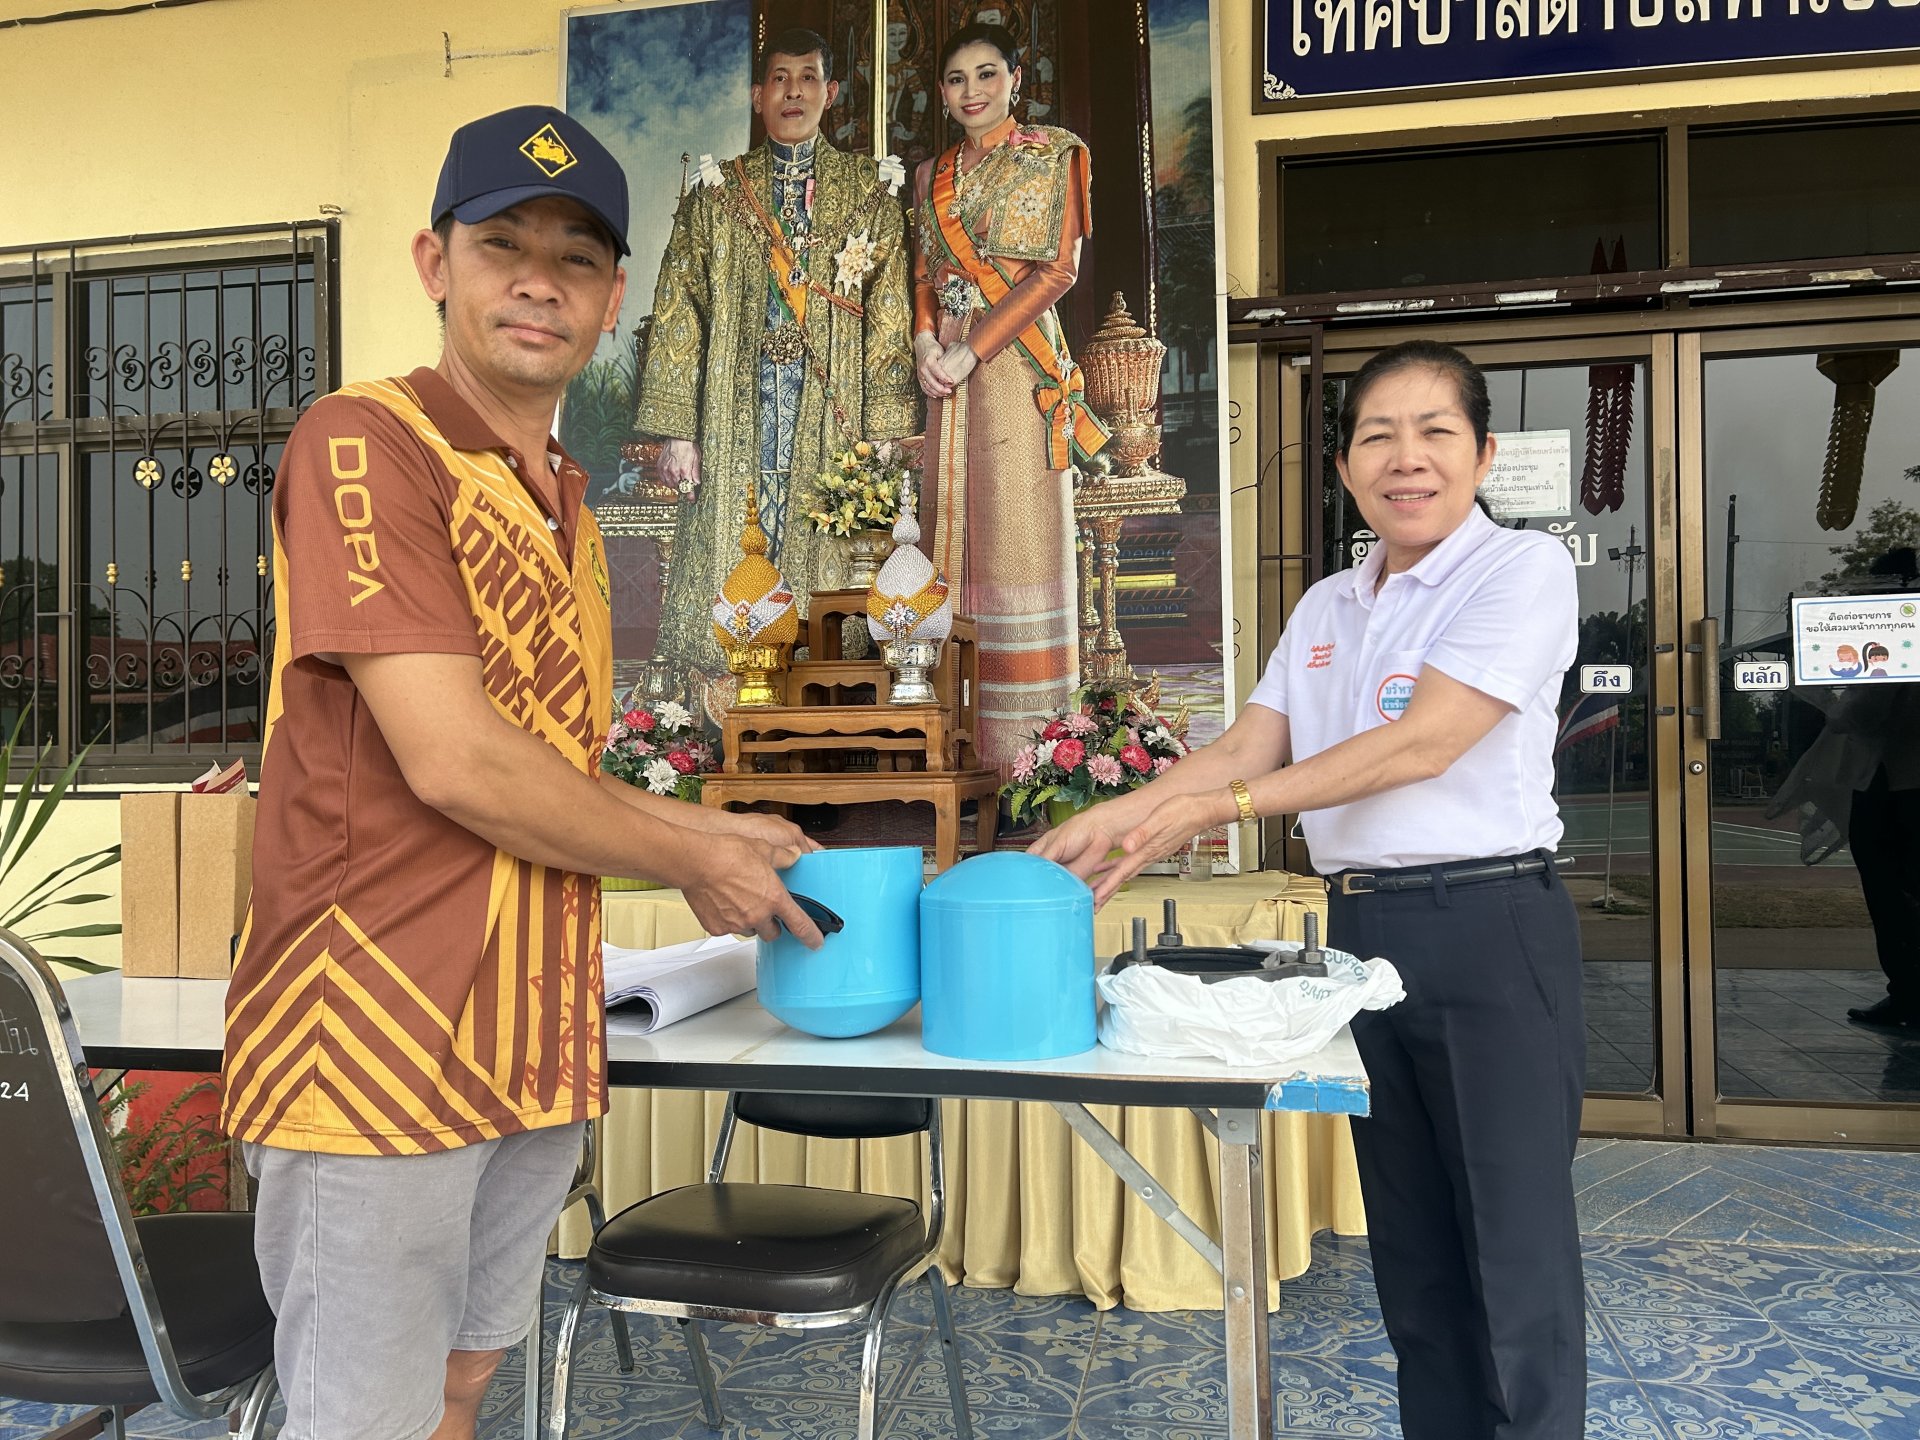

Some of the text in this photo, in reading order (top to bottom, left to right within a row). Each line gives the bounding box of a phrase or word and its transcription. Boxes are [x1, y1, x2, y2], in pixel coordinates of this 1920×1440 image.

[328, 435, 385, 607] DOPA
[1828, 611, 1892, 621] ติดต่อราชการ
[1806, 621, 1915, 633] ขอให้สวมหน้ากากทุกคน
[1593, 671, 1621, 688] ดึง
[1742, 666, 1782, 684] ผลัก
[1385, 683, 1415, 695] บริหา
